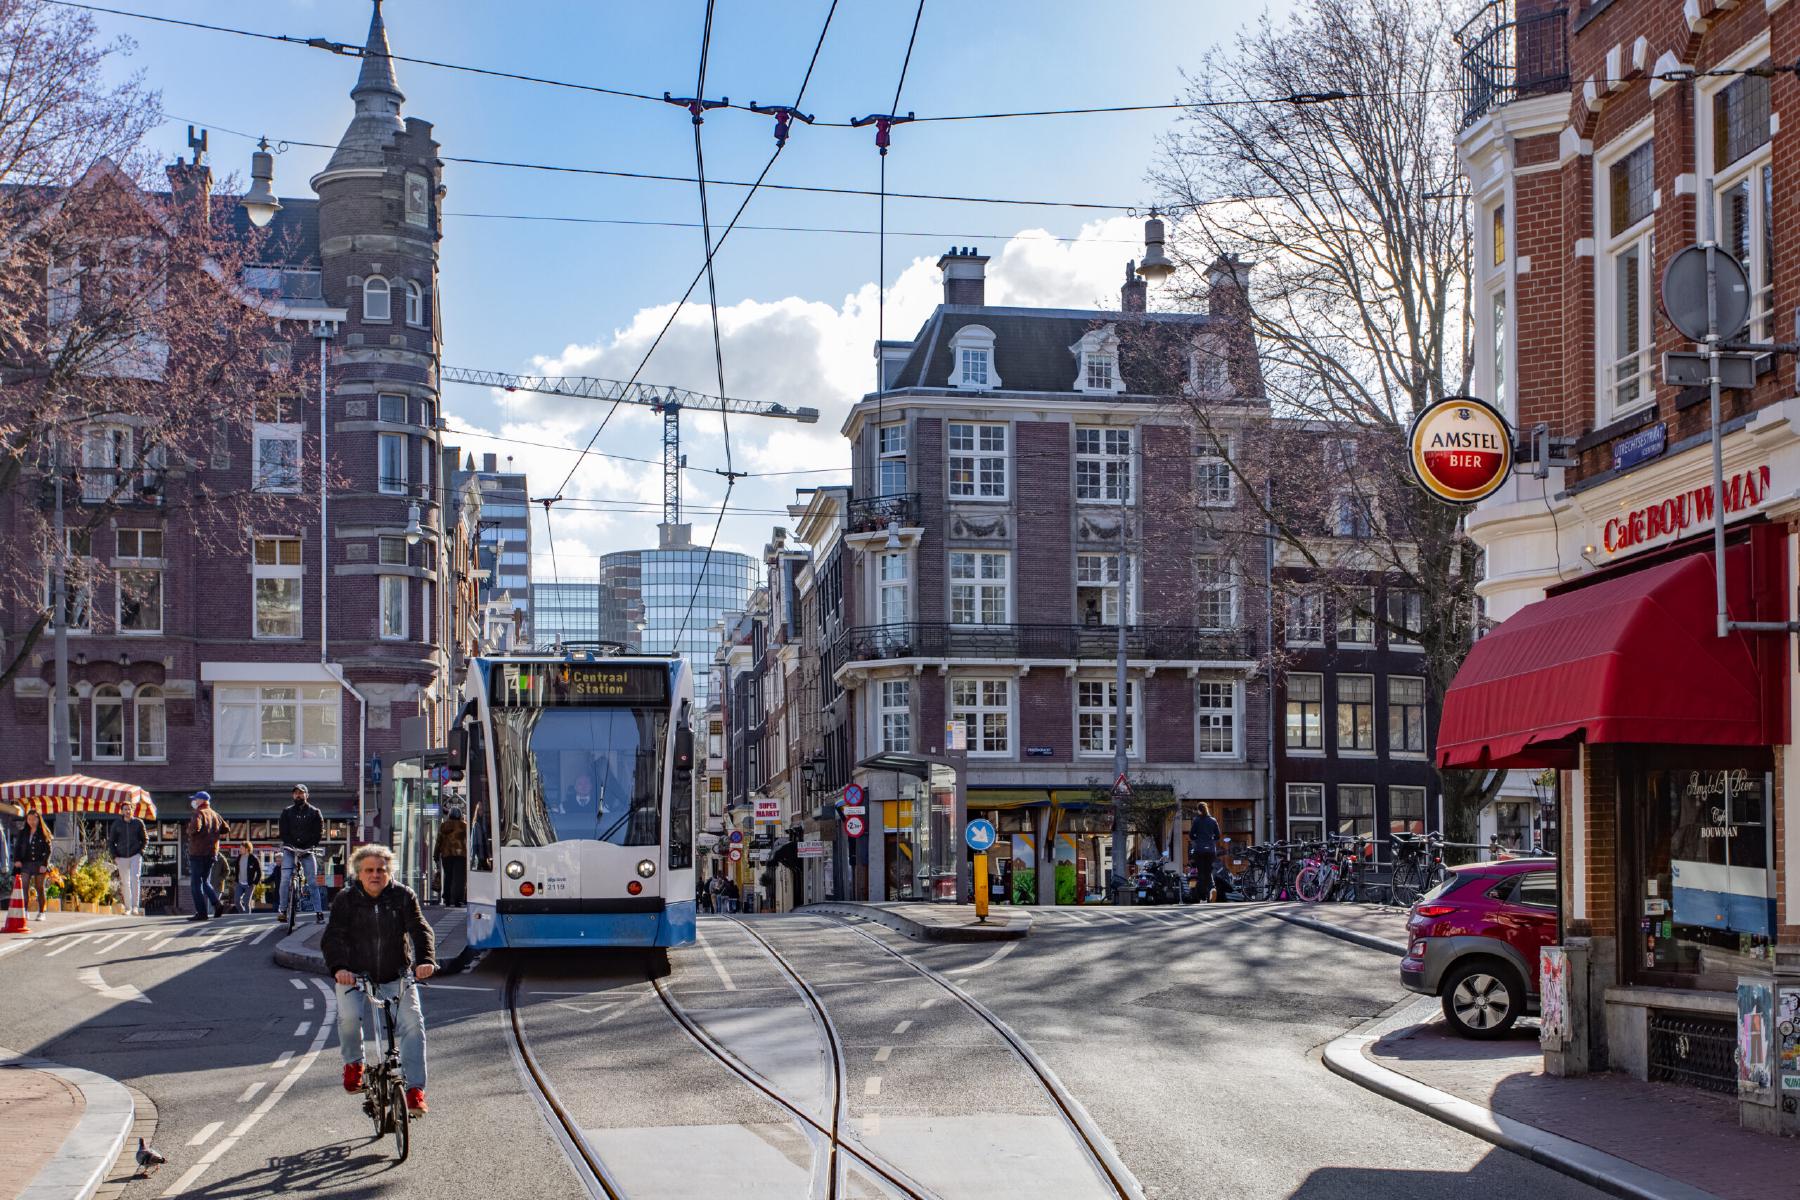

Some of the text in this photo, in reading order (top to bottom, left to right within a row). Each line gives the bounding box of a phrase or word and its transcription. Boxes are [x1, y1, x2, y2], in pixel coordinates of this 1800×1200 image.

[1431, 432, 1498, 449] AMSTEL
[1449, 454, 1482, 468] BIER
[1604, 465, 1771, 553] Café BOUWMAN
[573, 671, 628, 683] Centraal
[576, 683, 624, 695] Station
[756, 810, 780, 818] MARKET
[1701, 826, 1738, 838] BOUWMAN
